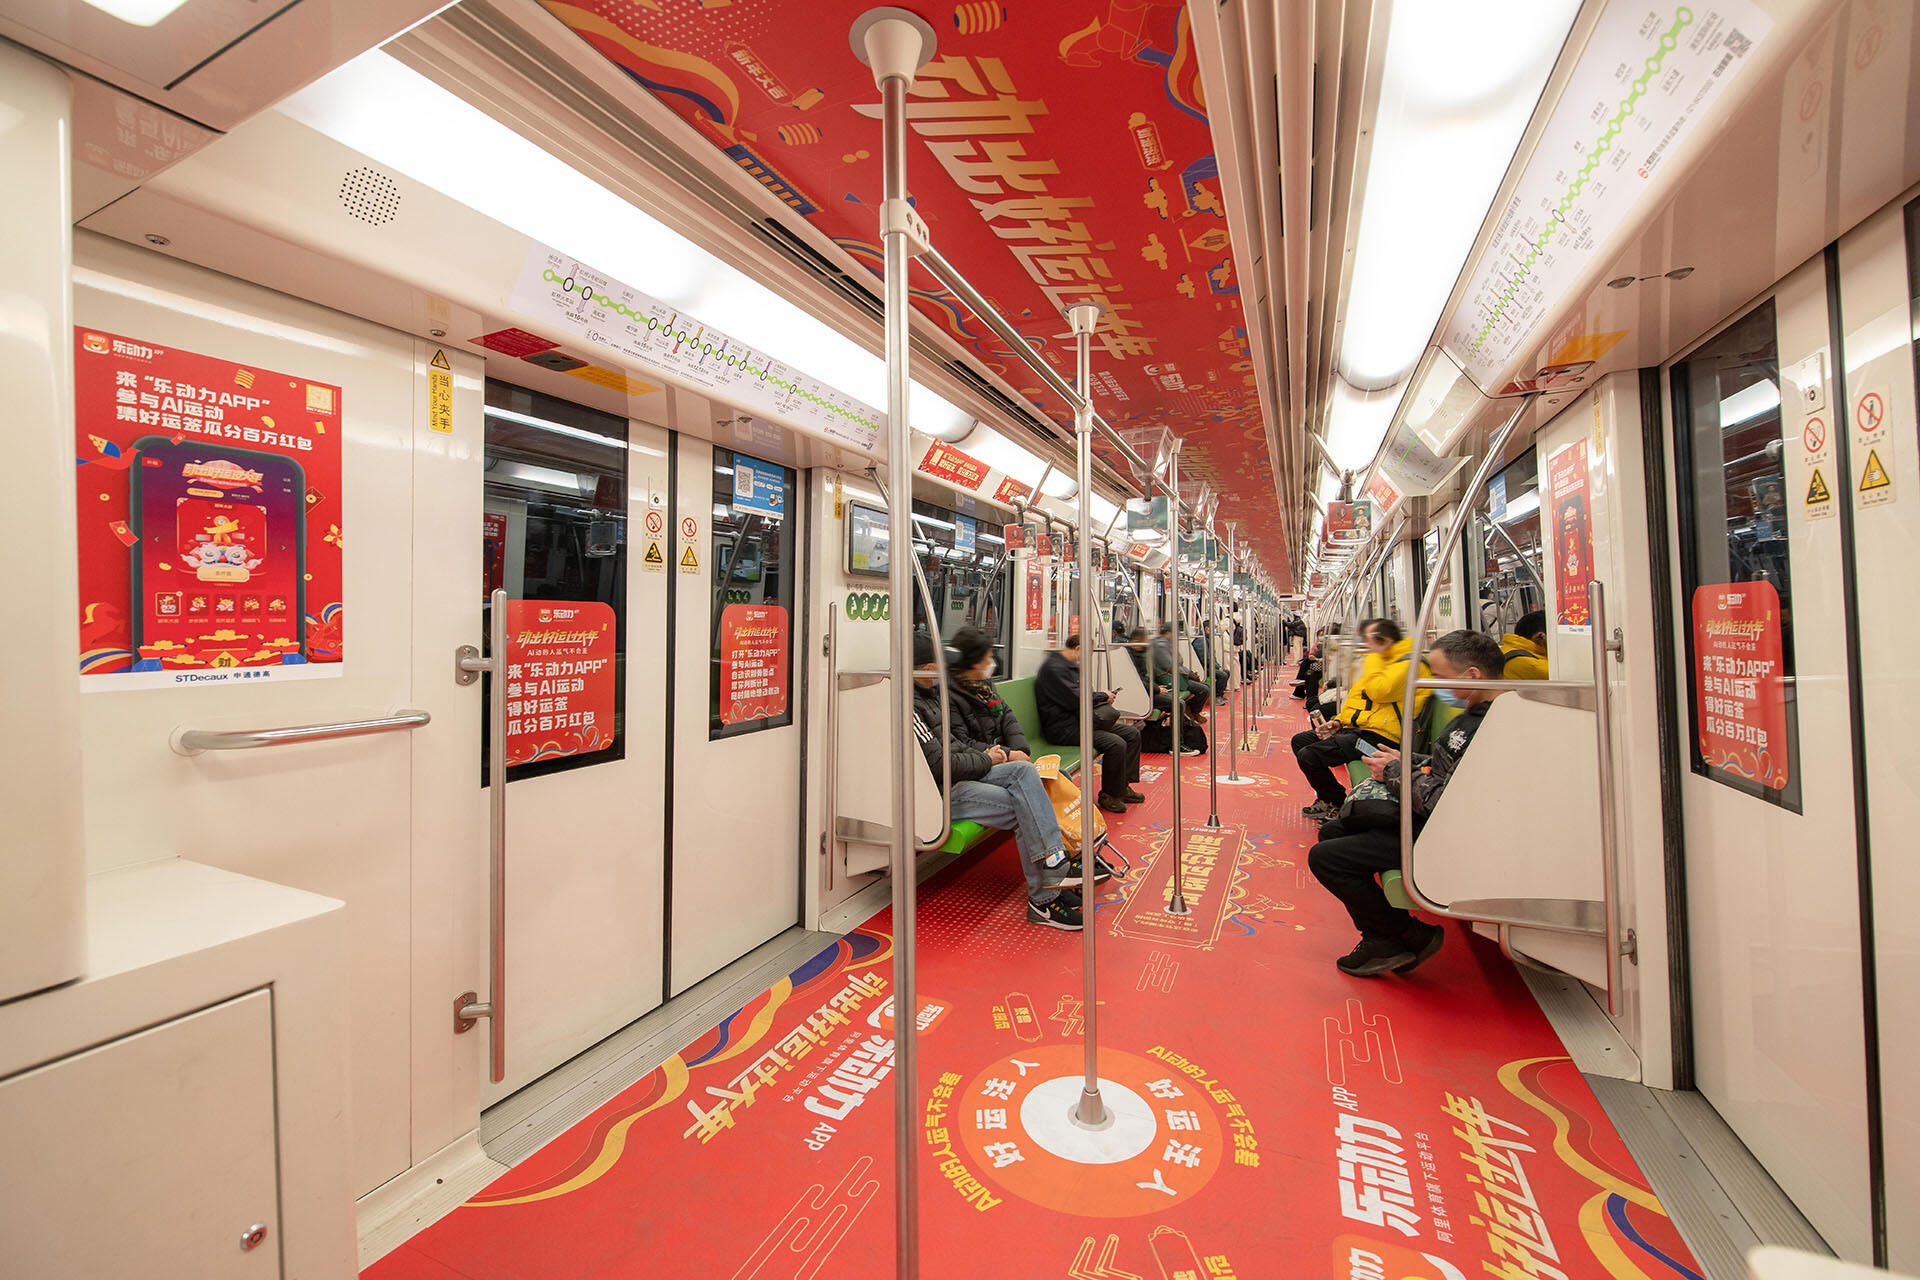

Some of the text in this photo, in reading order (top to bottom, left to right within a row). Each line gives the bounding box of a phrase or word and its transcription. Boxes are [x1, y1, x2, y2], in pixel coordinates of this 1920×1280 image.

[731, 48, 788, 99] 新年大吉
[112, 339, 153, 359] 乐动力
[116, 388, 224, 421] 参与AI运动
[116, 405, 313, 452] 集好运签瓜分百万红包
[516, 629, 600, 649] 动出好运过大年
[175, 672, 228, 683] STDecaux
[507, 677, 585, 699] 参与AI运动
[1704, 675, 1756, 700] 参与AI运动
[507, 696, 568, 718] 得好运签
[1704, 695, 1745, 720] 得好运签
[507, 711, 596, 737] 瓜分百万红包
[1706, 716, 1768, 747] 瓜分百万红包
[683, 971, 888, 1145] 动出好运过大年
[804, 1034, 895, 1121] 乐动力
[1146, 1045, 1260, 1169] AI动的人运气不会差
[1332, 1086, 1358, 1112] APP
[803, 1121, 837, 1151] APP
[924, 1071, 1003, 1213] AI动的人运气不会差
[1334, 1112, 1422, 1237] 乐动力
[1413, 1131, 1456, 1244] 阿里体育旗下运动平台
